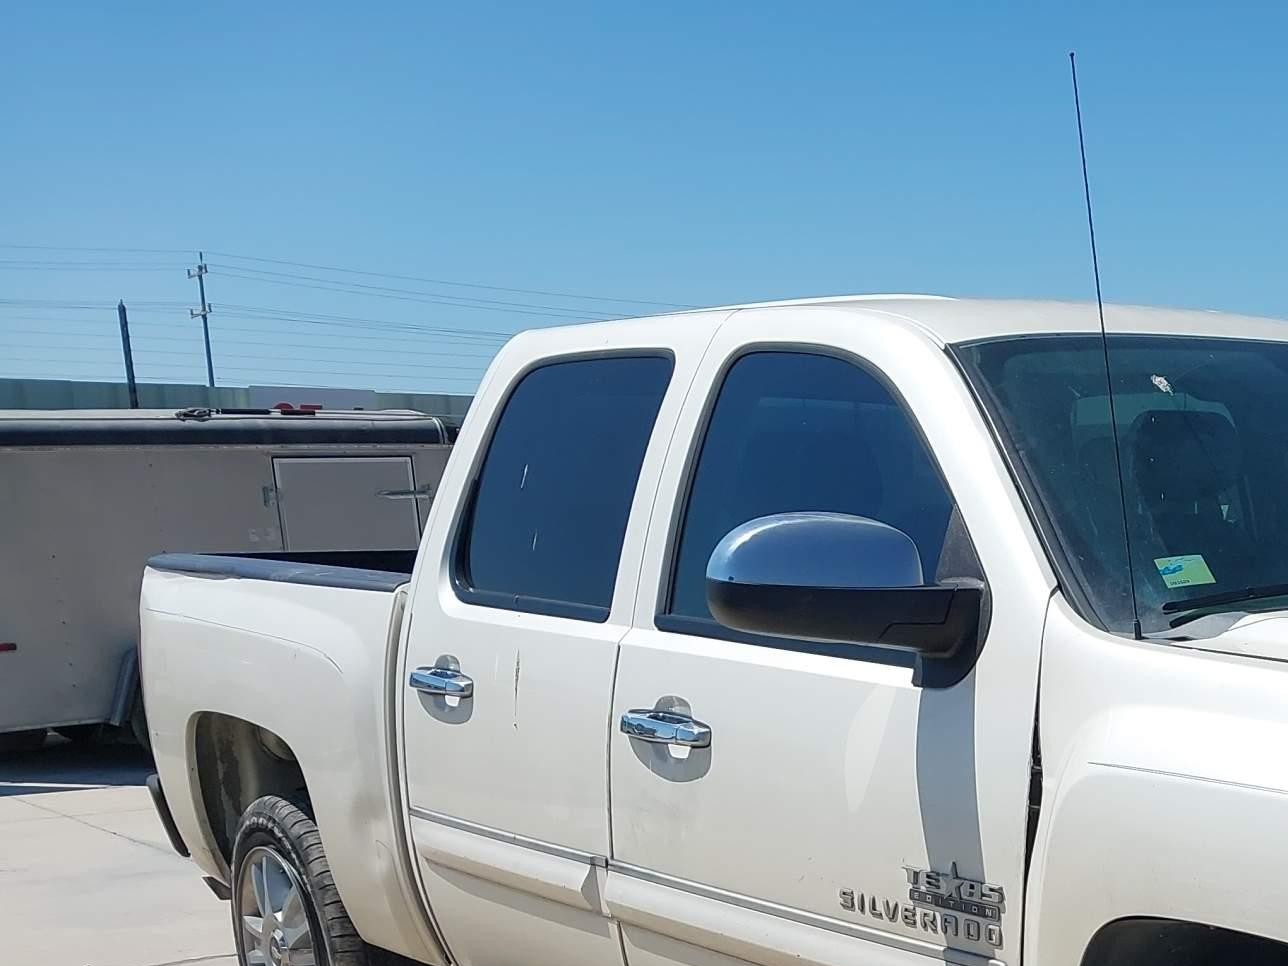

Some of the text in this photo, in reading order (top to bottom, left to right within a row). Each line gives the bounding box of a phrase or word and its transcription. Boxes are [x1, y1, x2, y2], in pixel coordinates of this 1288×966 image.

[902, 862, 1006, 904] TEXAS
[838, 888, 1003, 948] SILVERADO
[912, 892, 995, 918] EDITION
